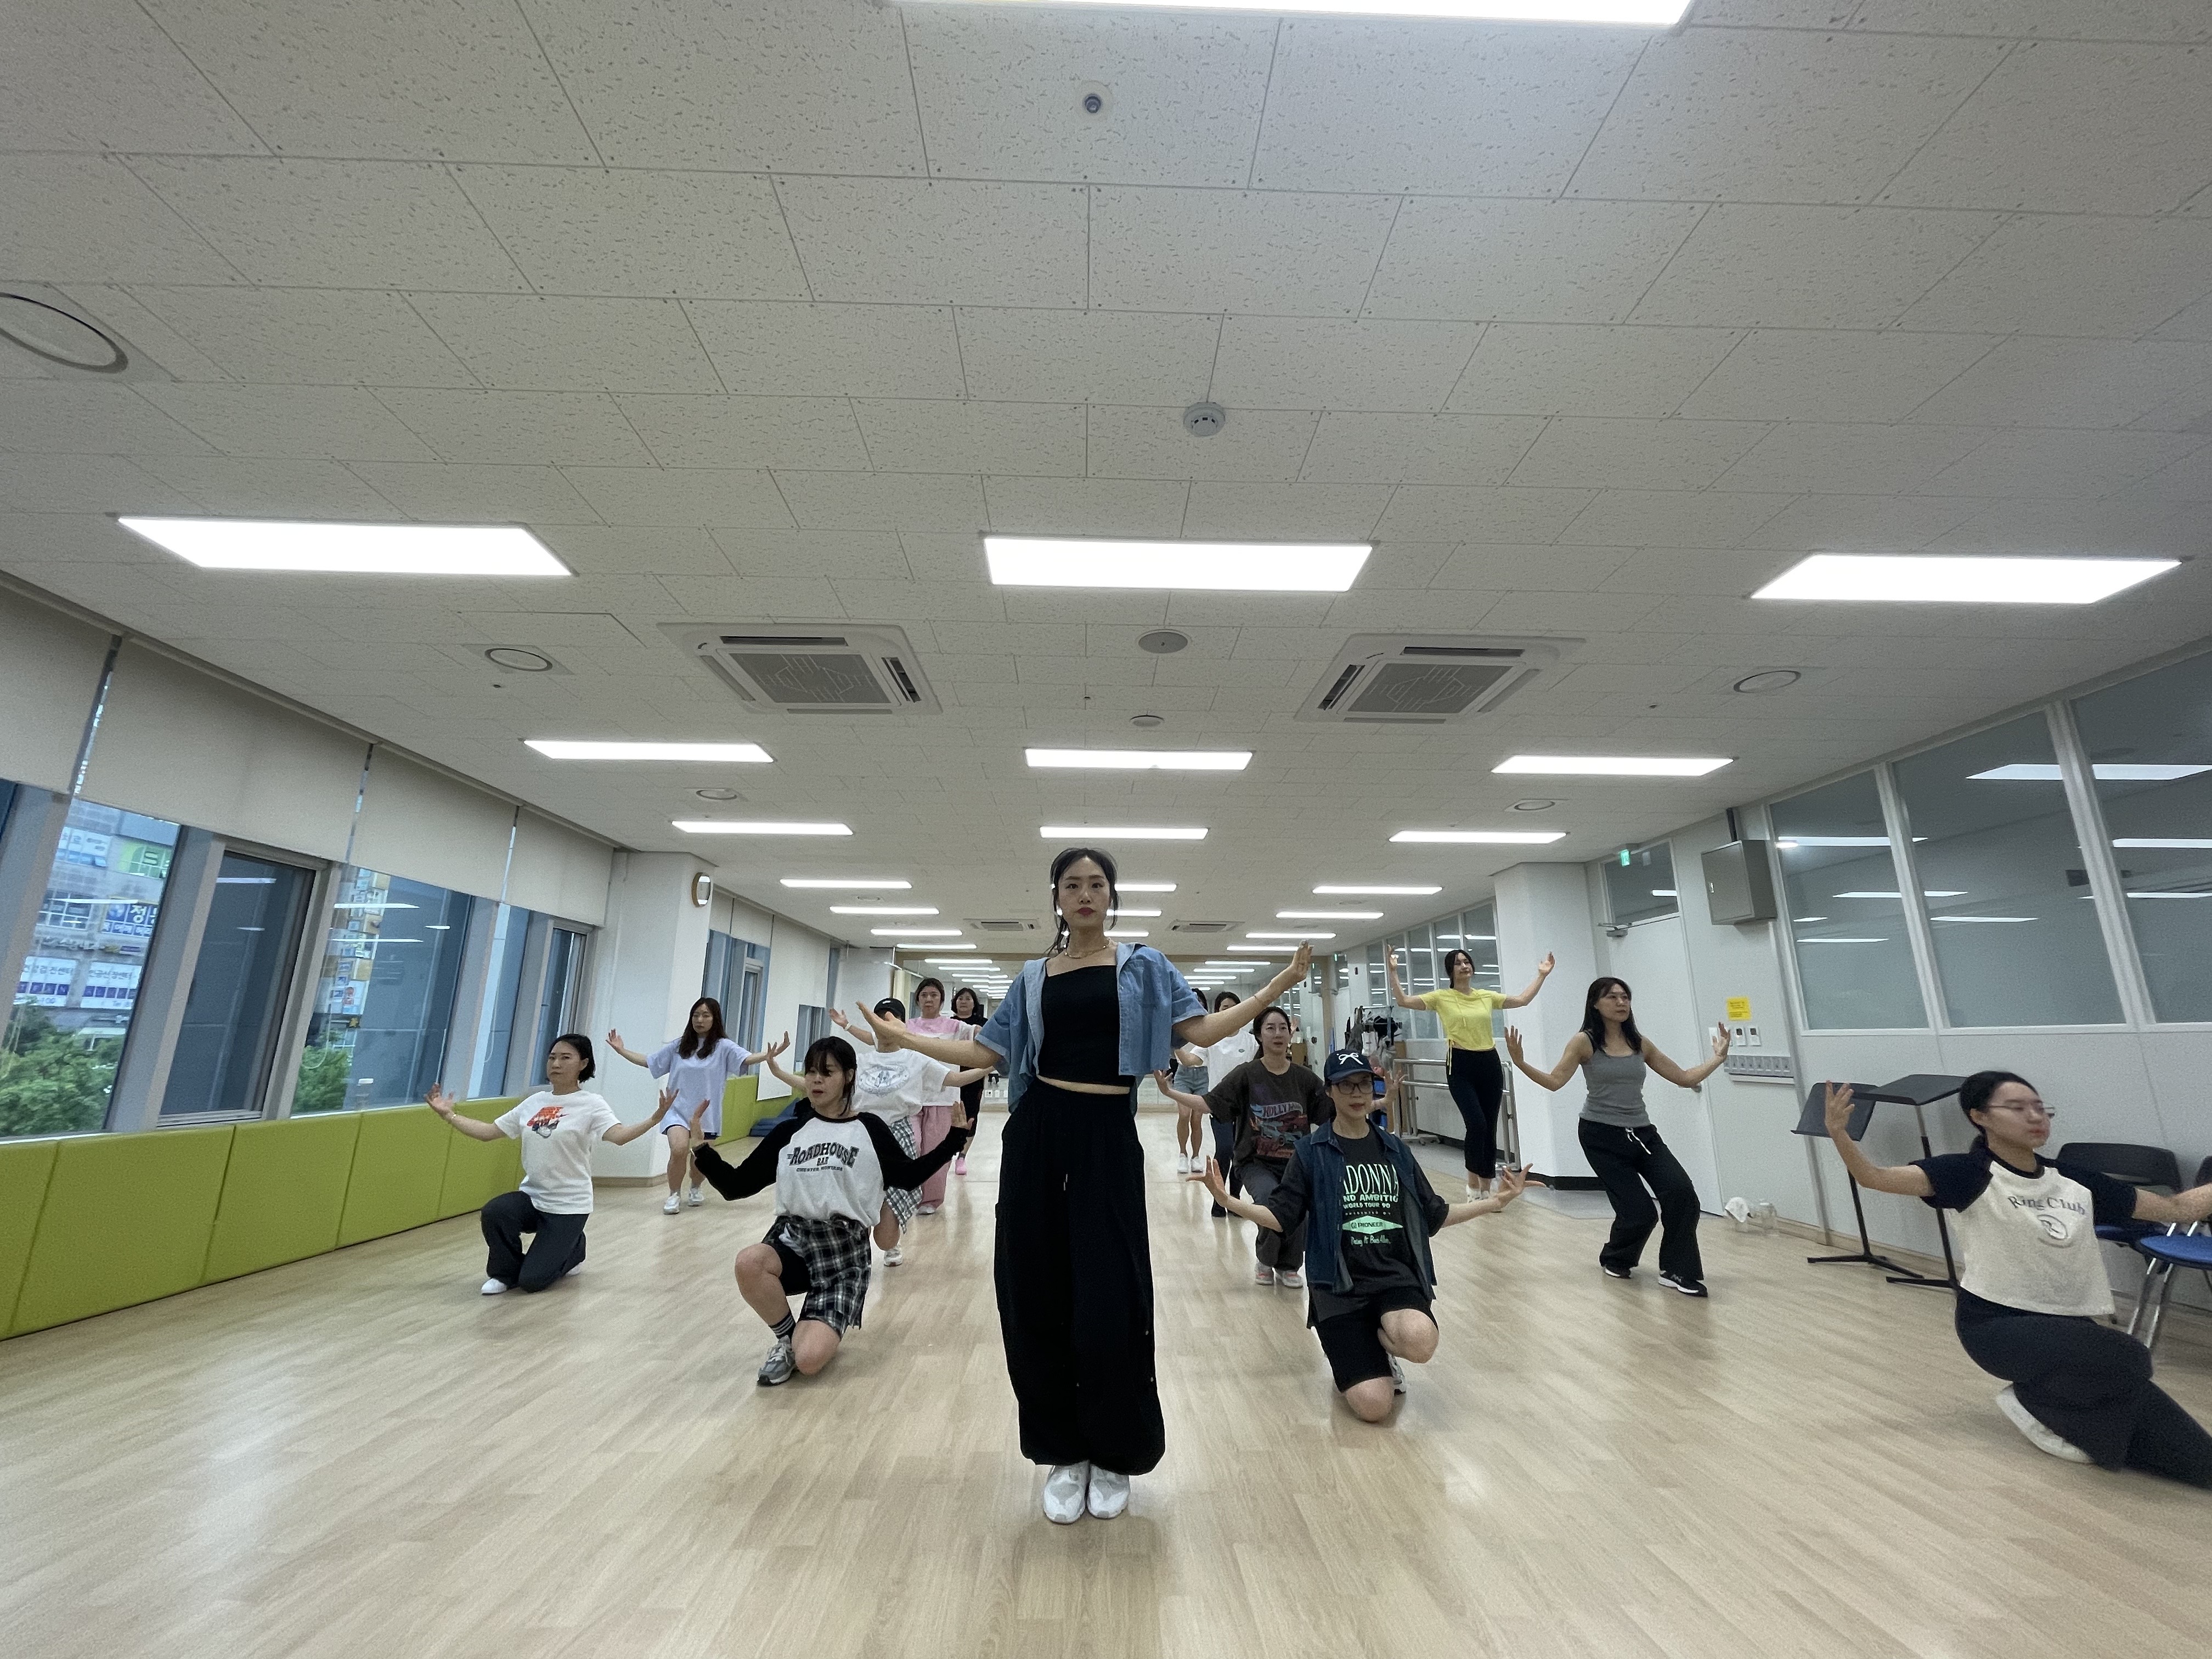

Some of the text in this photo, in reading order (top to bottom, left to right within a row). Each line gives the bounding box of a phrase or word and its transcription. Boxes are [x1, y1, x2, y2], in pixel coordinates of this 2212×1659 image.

[789, 1142, 860, 1168] ROADHOUSE
[2007, 1195, 2085, 1215] Ring Club
